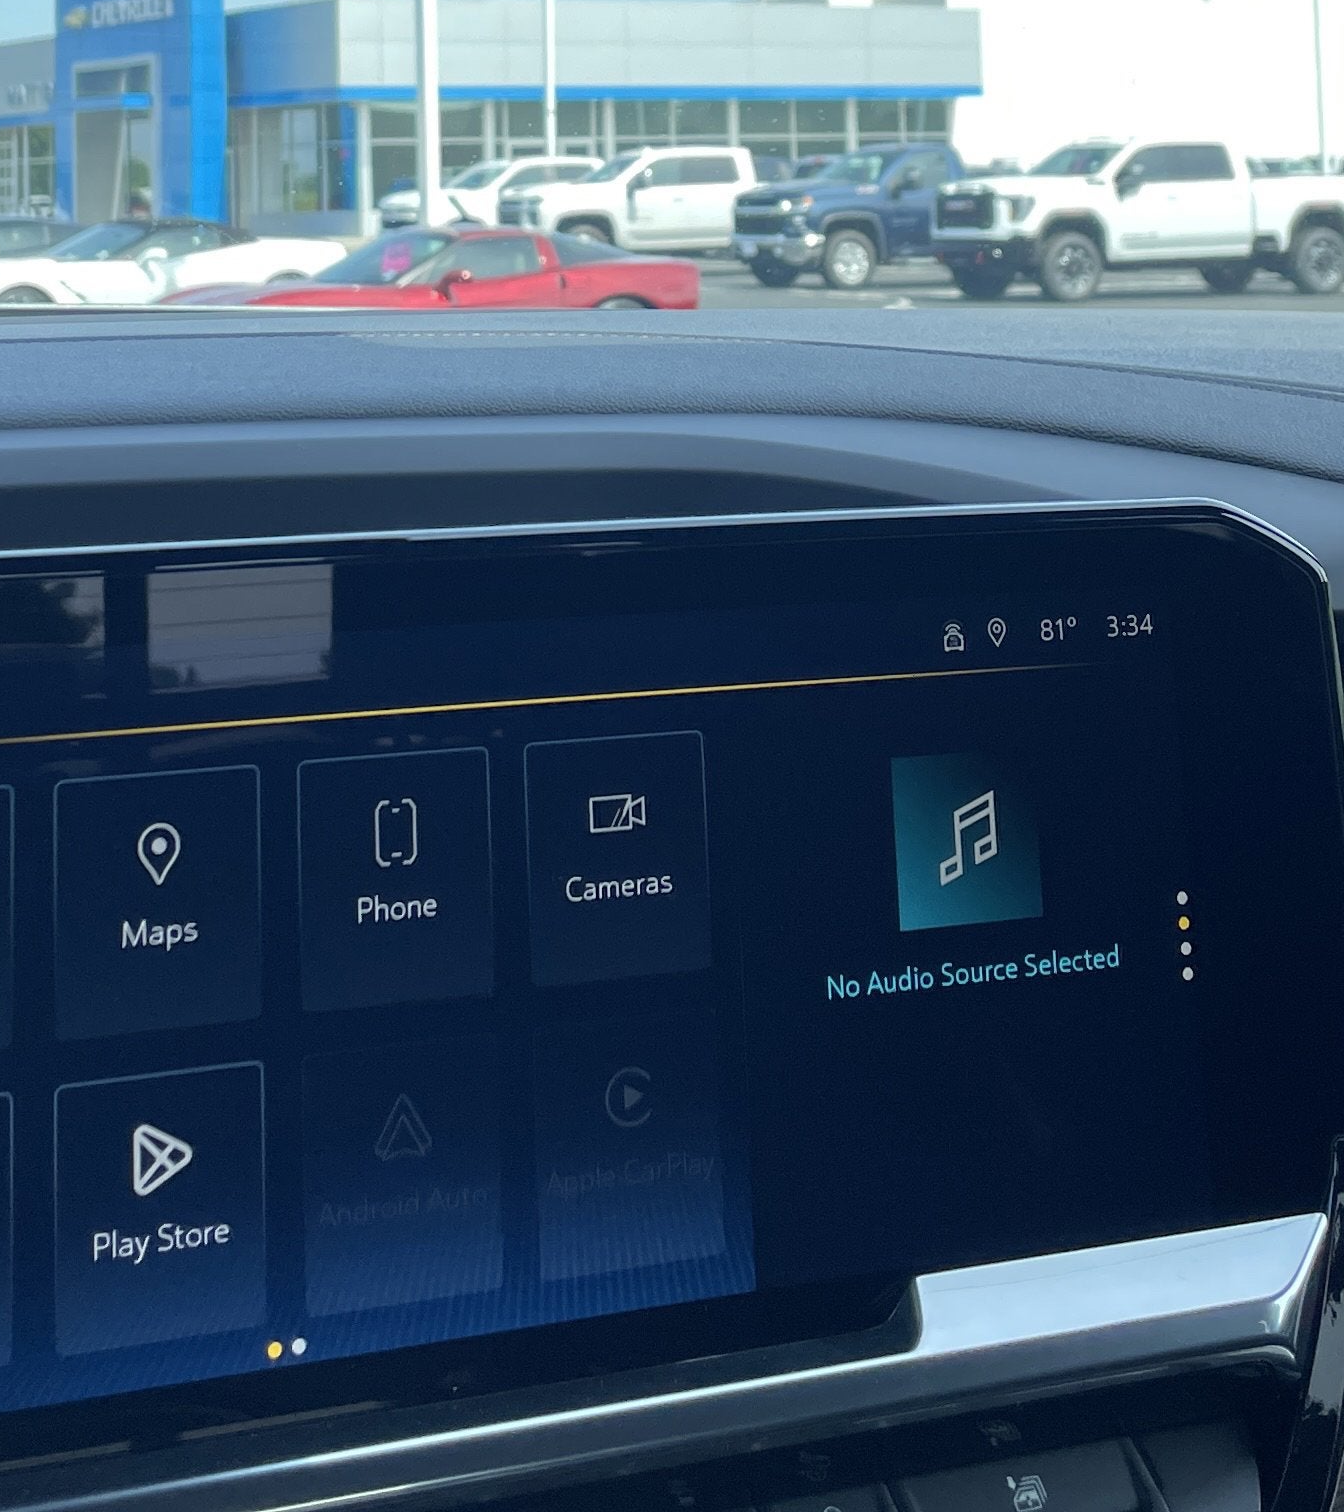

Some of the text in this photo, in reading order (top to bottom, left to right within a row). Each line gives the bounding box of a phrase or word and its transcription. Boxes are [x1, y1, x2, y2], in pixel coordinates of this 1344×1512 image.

[1107, 613, 1154, 638] 3:34
[565, 874, 673, 902] Cameras
[357, 894, 438, 924] Phone
[121, 918, 199, 951] Maps
[827, 943, 1120, 1001] No Audio Source Selected
[546, 1151, 715, 1201] Apple CarPlay
[318, 1186, 489, 1227] Android Auto
[92, 1223, 230, 1265] Play Store
